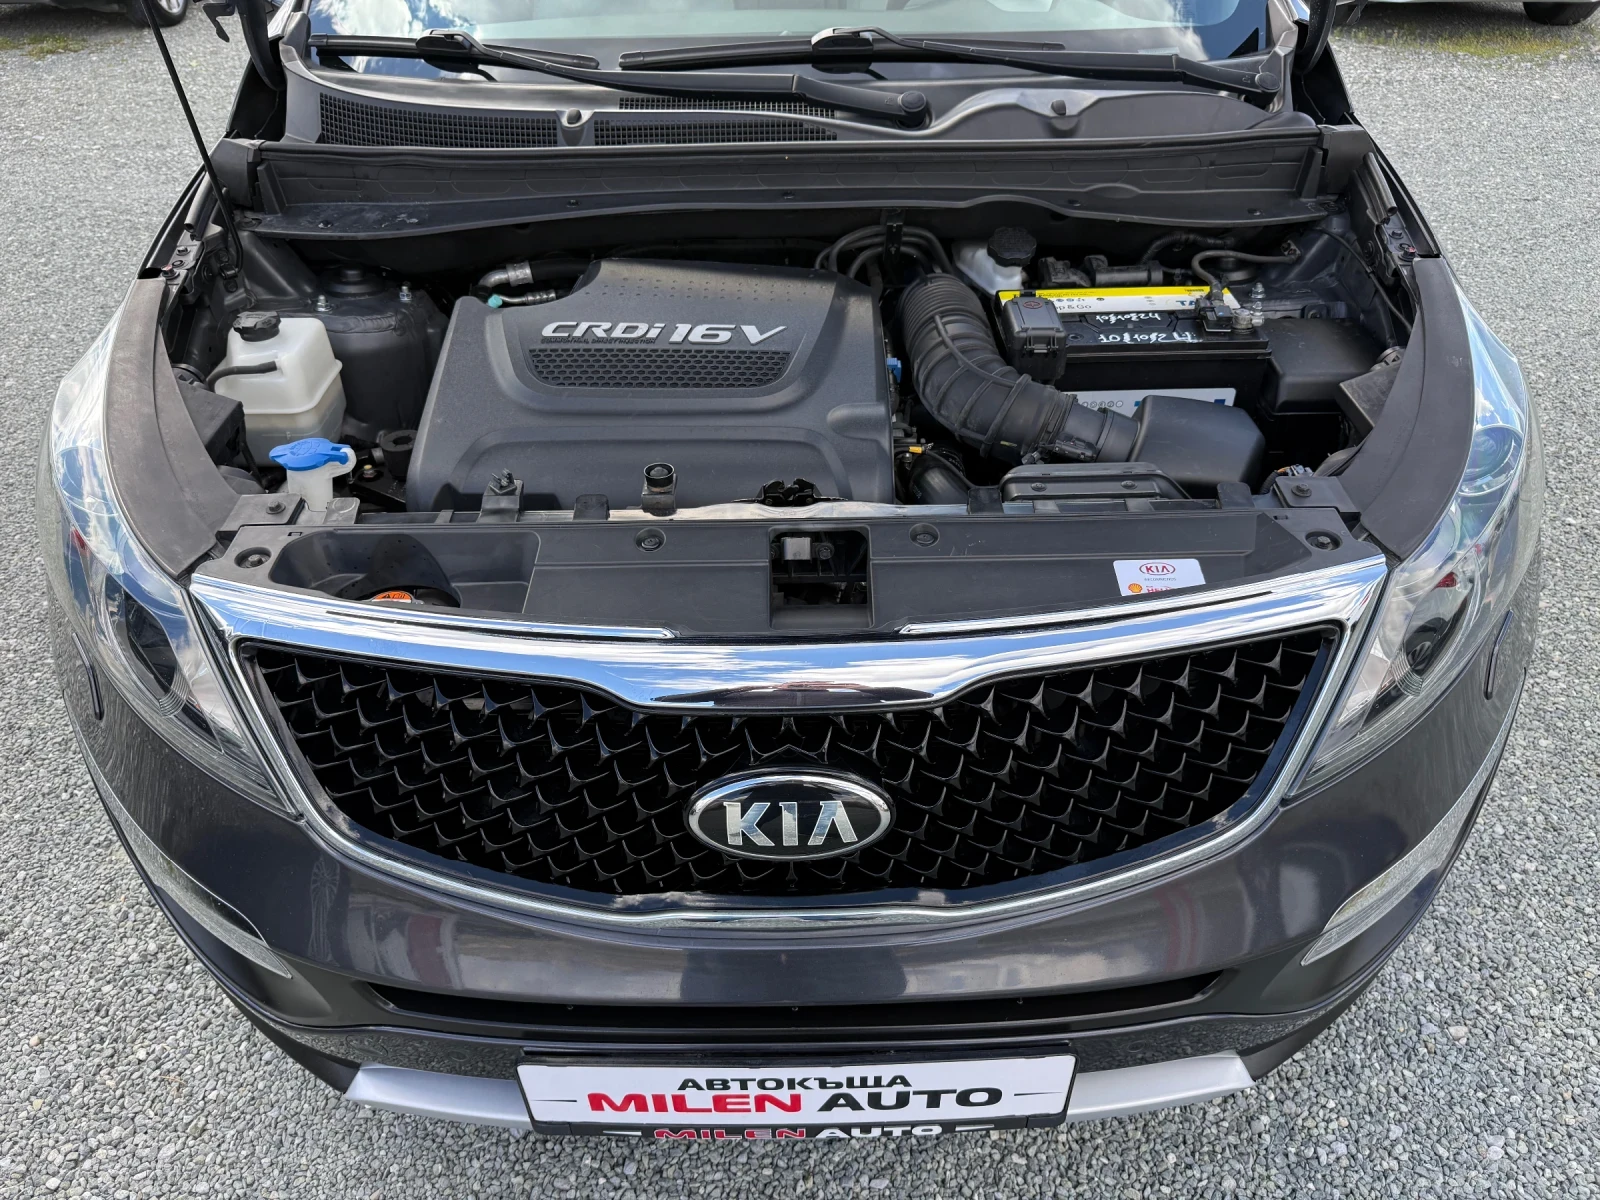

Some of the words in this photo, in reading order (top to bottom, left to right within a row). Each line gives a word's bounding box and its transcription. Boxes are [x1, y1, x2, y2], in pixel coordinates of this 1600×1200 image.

[541, 321, 666, 339] CRDi
[1145, 565, 1170, 573] KIA
[723, 801, 858, 846] KIA
[677, 1074, 913, 1091] АВТОКЪША
[587, 1092, 802, 1113] MILEN
[817, 1087, 1003, 1112] AUTO
[654, 1128, 806, 1140] MILEN
[815, 1125, 942, 1139] AUTO
